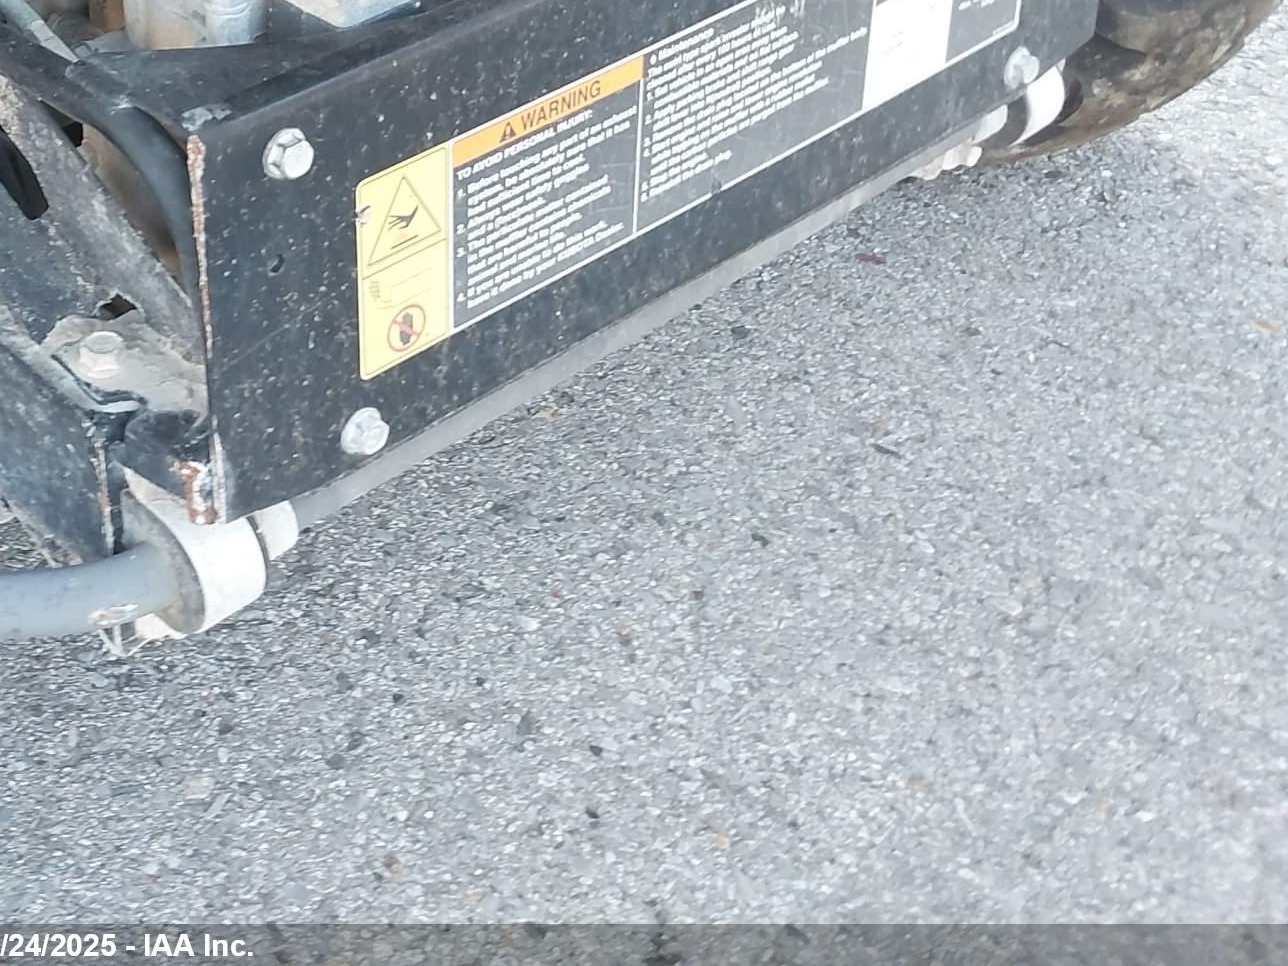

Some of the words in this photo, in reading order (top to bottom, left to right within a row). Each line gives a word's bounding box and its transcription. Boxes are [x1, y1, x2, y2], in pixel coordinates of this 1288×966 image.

[521, 80, 601, 131] WARNING
[456, 167, 471, 180] TO
[472, 152, 503, 173] AVOID
[504, 127, 556, 158] PERSONAL
